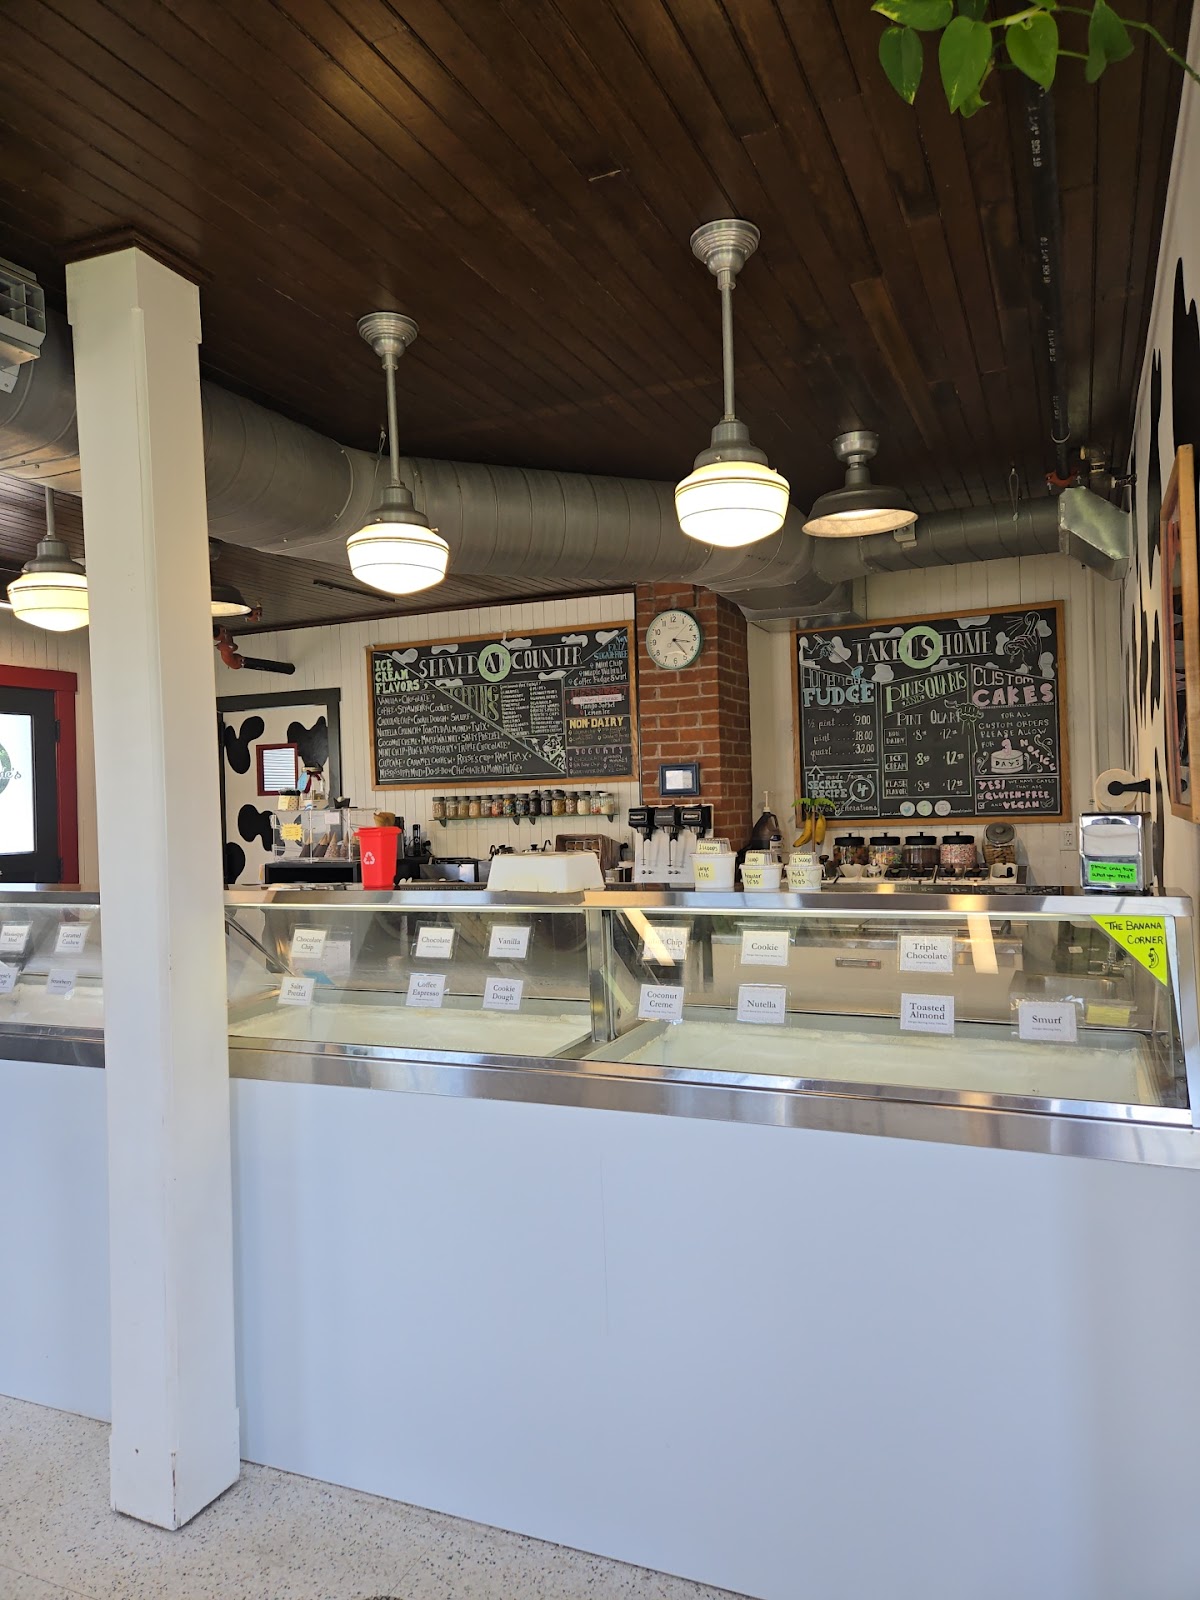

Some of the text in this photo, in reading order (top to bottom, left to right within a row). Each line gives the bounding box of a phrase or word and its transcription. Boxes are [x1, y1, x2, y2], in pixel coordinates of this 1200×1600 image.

[907, 635, 933, 660] US
[940, 631, 992, 656] HOME
[375, 659, 394, 672] ICE
[419, 646, 583, 678] SERVED AT COUNTER
[376, 668, 409, 682] CREAM
[974, 667, 1034, 686] CUSTOM
[376, 679, 420, 694] FLAVORS
[924, 671, 967, 700] QUARTS
[802, 683, 874, 708] FUDGE
[885, 680, 925, 714] PINTS
[972, 683, 1054, 707] CAKES
[570, 716, 624, 729] NON-DAIRY
[818, 718, 836, 730] pint
[897, 712, 923, 726] PINT
[1016, 718, 1049, 728] ORDERS
[470, 722, 488, 732] TWIX
[980, 728, 1047, 738] PLEASE ALLOW
[814, 733, 830, 745] pint
[1002, 739, 1012, 756] 3
[810, 746, 832, 762] quart
[1020, 739, 1056, 772] NOTICE
[808, 780, 844, 790] SECRET
[978, 780, 1006, 790] YES!
[812, 788, 848, 799] RECIPE
[857, 783, 868, 798] 4
[985, 790, 1050, 800] GLUTEN-FREE
[1002, 800, 1040, 810] VEGAN
[1104, 920, 1162, 930] THE BANANA
[296, 936, 322, 944] Chocolate
[422, 936, 450, 944] Chocolate
[498, 938, 521, 946] Vanilla
[666, 938, 682, 947] Chip
[1127, 935, 1164, 944] CORNER
[751, 942, 779, 951] Cookie
[912, 942, 938, 952] Triple
[906, 952, 948, 960] Chocolate
[50, 978, 73, 986] Strawberry
[288, 990, 306, 998] Pretzel
[412, 989, 440, 998] Espresso
[492, 993, 514, 1002] Dough
[647, 990, 678, 1000] Coconut
[649, 1000, 674, 1008] Creme
[747, 1000, 777, 1008] Nutella
[910, 1002, 946, 1012] Toasted
[910, 1011, 946, 1020] Almond
[1032, 1015, 1062, 1024] Smurf
